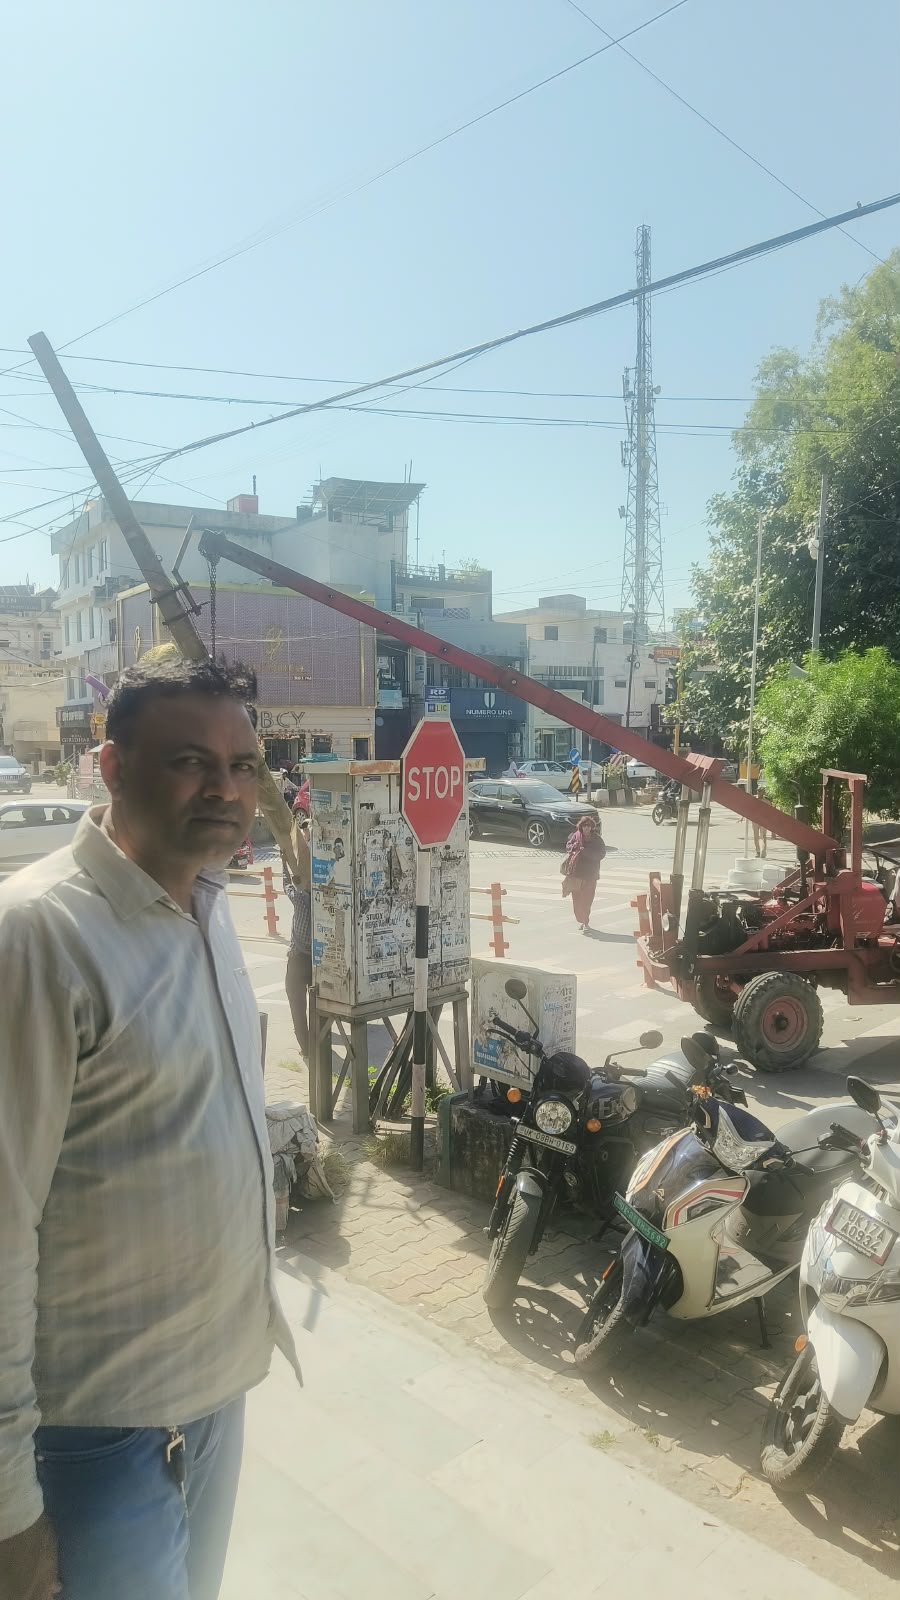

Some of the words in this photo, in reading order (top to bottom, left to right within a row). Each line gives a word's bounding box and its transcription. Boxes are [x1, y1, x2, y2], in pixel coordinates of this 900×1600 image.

[436, 704, 447, 712] LIC
[260, 711, 306, 728] BCY
[408, 765, 461, 802] STOP
